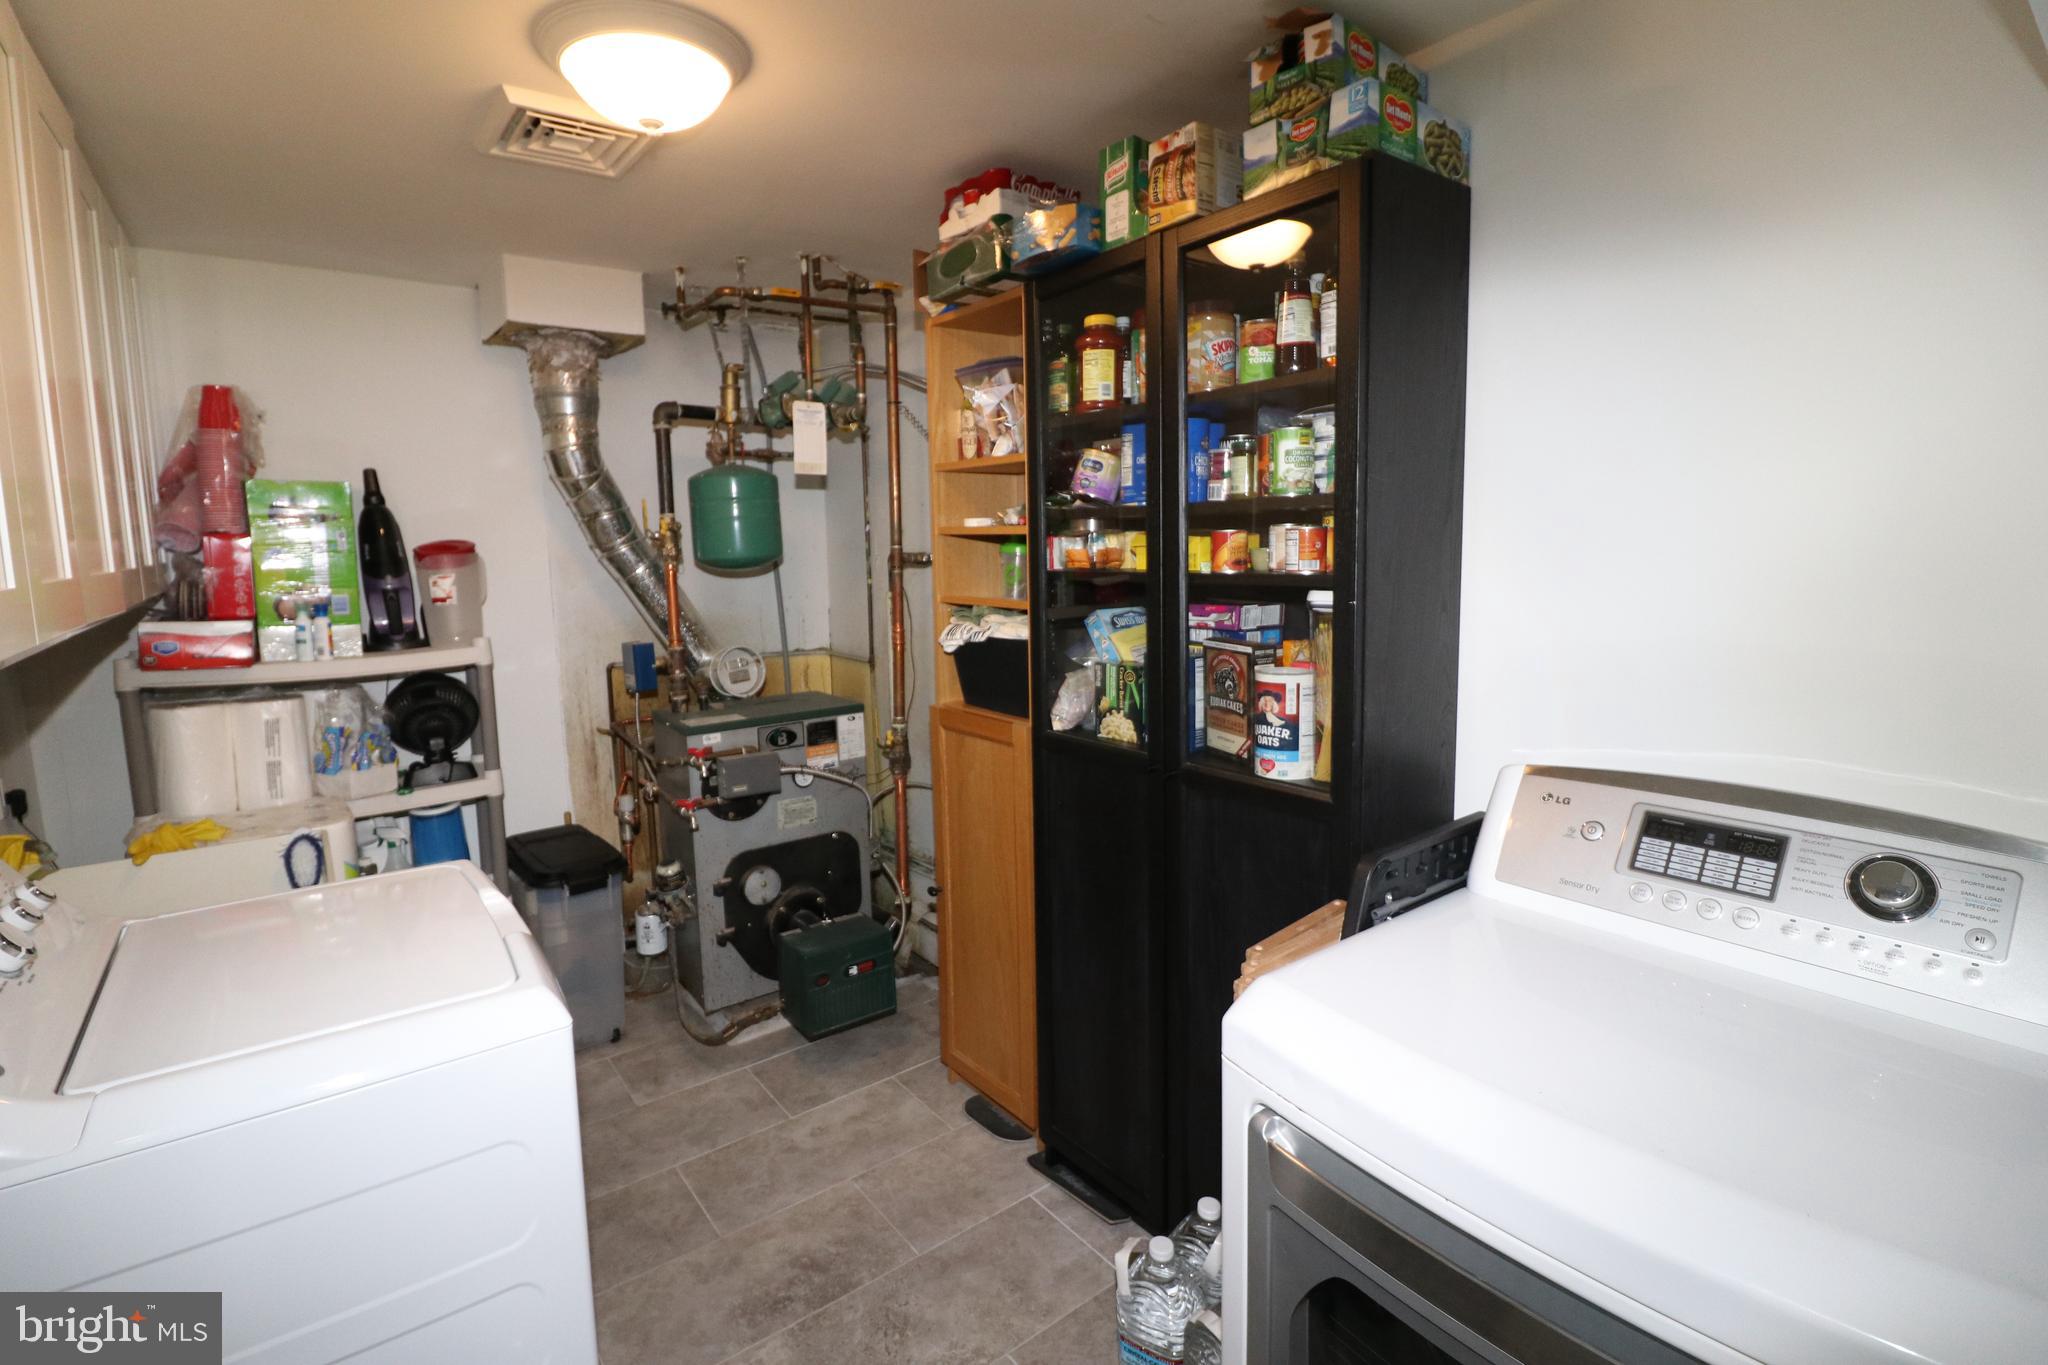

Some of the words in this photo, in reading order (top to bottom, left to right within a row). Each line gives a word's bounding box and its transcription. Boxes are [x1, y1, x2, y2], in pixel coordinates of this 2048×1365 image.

[1351, 85, 1365, 101] 12
[1395, 106, 1412, 122] Monte
[1226, 699, 1244, 714] CAKES
[1257, 735, 1280, 747] OATS
[1555, 796, 1571, 806] LG
[1982, 872, 2007, 882] TOWELS
[1559, 877, 1585, 889] Sensor
[1585, 883, 1600, 894] Dry
[1960, 879, 1985, 888] SPORTS
[1985, 883, 2006, 892] WEAR
[1960, 890, 1983, 899] SMALL
[1984, 895, 2003, 904] LOAD
[1964, 901, 1986, 911] SPEED
[1957, 911, 1988, 922] FRESHEN
